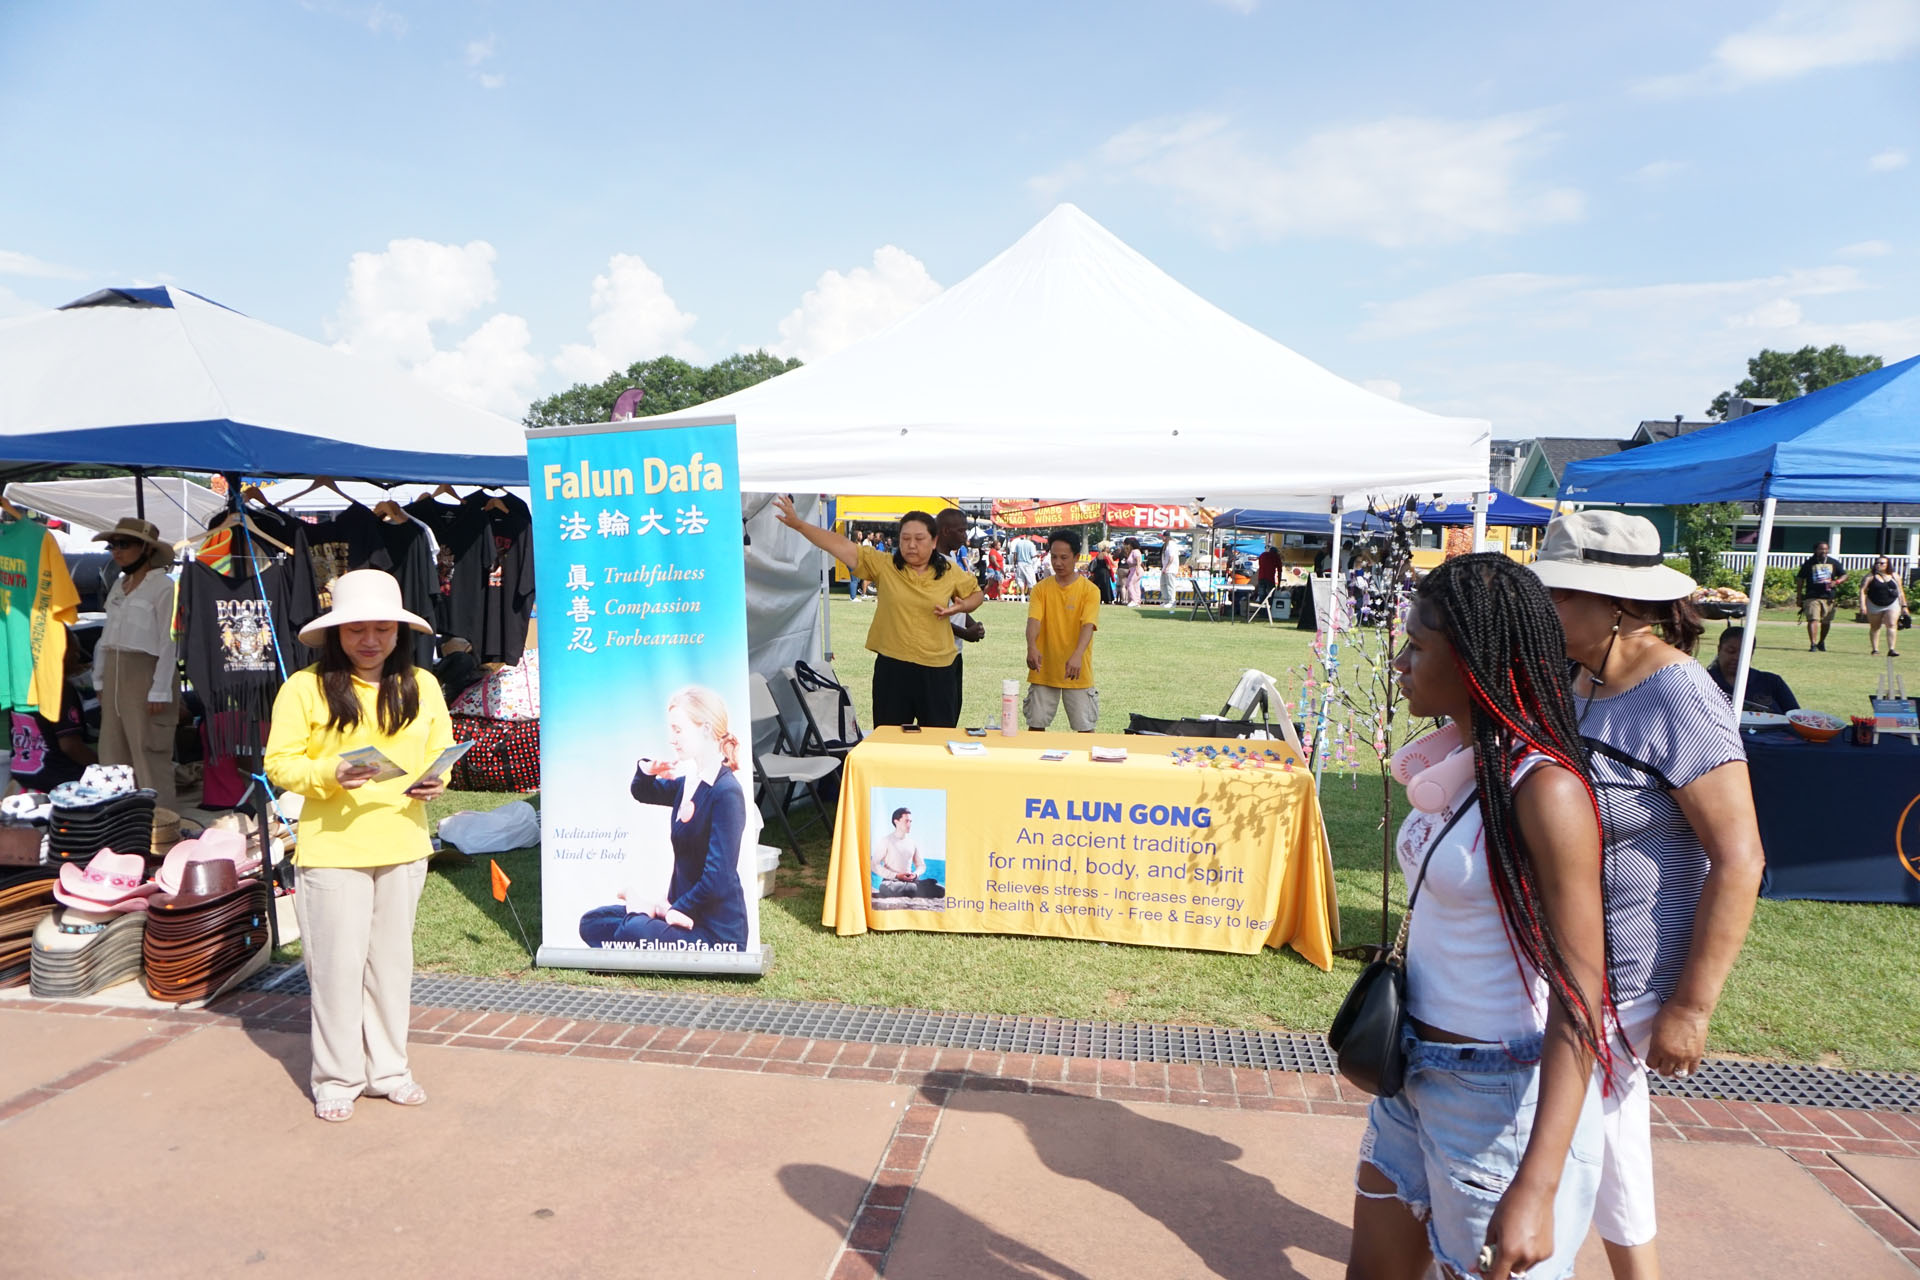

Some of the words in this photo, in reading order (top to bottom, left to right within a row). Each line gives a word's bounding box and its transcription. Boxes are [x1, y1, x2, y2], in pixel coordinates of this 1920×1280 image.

[544, 460, 634, 500] Falun
[643, 452, 724, 494] Dafa
[560, 504, 709, 541] 法輪大法
[1034, 514, 1062, 524] WINGS
[1072, 510, 1101, 521] FINGERS
[1108, 506, 1137, 521] Fried
[1134, 507, 1185, 527] FISH
[604, 564, 705, 588] Truthfulness
[604, 598, 702, 620] Compassion
[605, 629, 705, 648] Forbearance
[1025, 798, 1060, 820] FA
[1066, 800, 1122, 824] LUN
[1129, 804, 1212, 828] GONG
[553, 827, 610, 840] Meditation
[612, 827, 629, 842] for
[1016, 828, 1044, 846] An
[1052, 831, 1126, 850] accient
[1133, 834, 1217, 856] tradition
[554, 848, 583, 860] Mind
[586, 848, 597, 860] &
[600, 848, 627, 863] Body
[988, 852, 1016, 869] for
[1022, 856, 1078, 876] mind,
[1086, 858, 1139, 880] body,
[1148, 864, 1186, 880] and
[1194, 866, 1245, 885] spirit
[986, 880, 1050, 896] Relieves
[1054, 884, 1098, 899] stress
[1114, 887, 1187, 904] Increases
[1192, 896, 1245, 912] energy
[946, 896, 985, 913] Bring
[990, 898, 1034, 913] health
[1040, 901, 1050, 913] &
[1055, 902, 1114, 920] serenity
[1129, 908, 1163, 922] Free
[1168, 910, 1179, 922] &
[1184, 912, 1222, 929] Easy
[1227, 915, 1241, 928] to
[601, 938, 738, 952] www.FalunDafa.org
